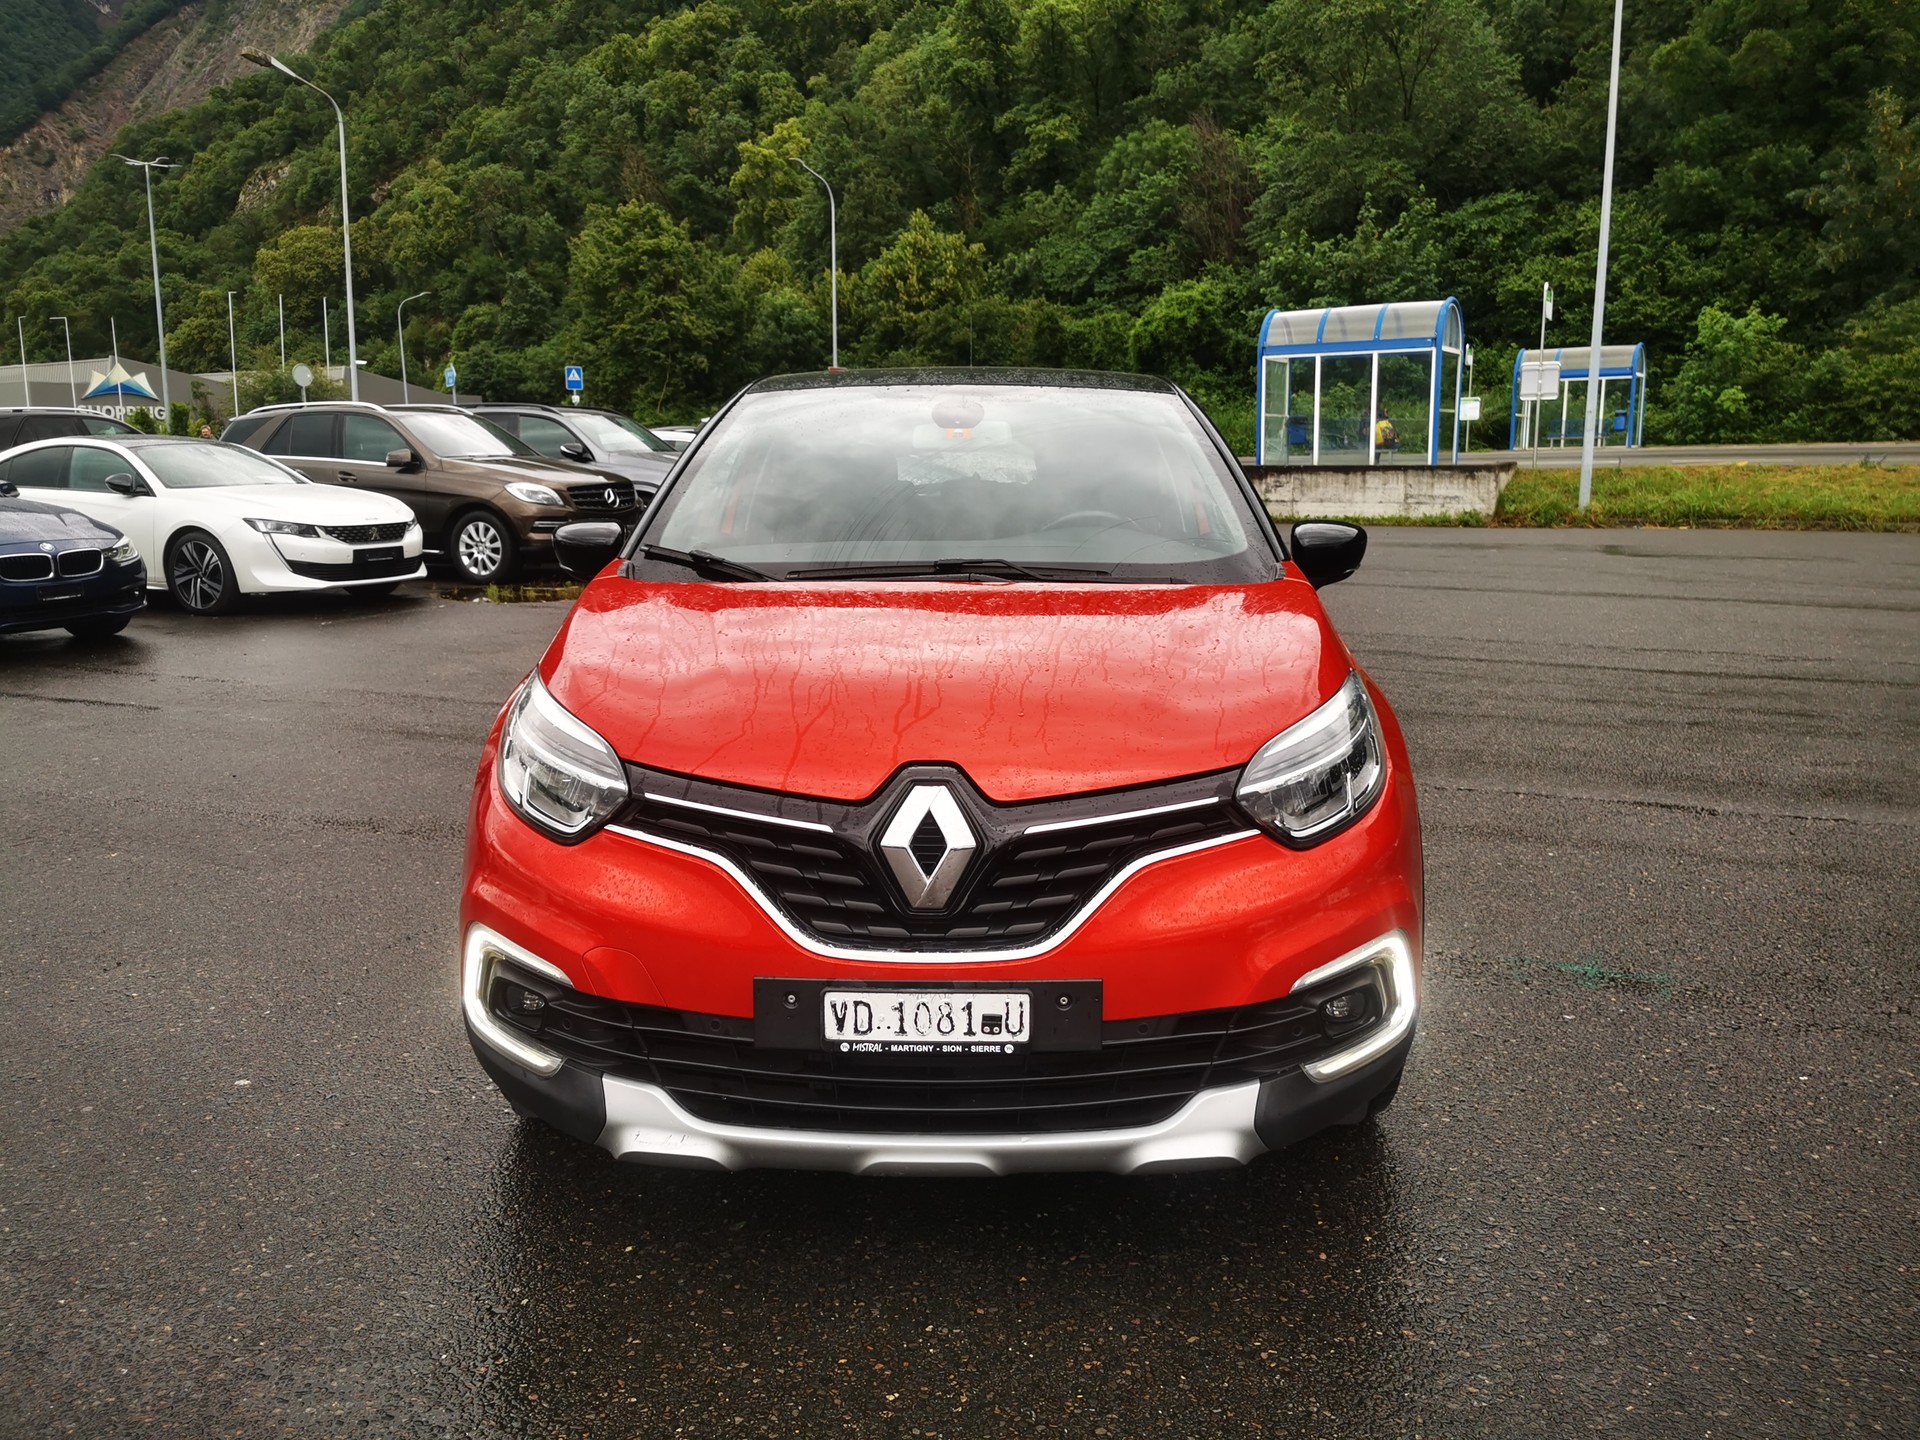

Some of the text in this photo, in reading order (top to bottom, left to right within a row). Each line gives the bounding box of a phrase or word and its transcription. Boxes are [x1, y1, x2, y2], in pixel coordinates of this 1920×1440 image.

[77, 405, 166, 420] SHOPPG
[830, 1000, 1025, 1036] VD 1081 U
[852, 1043, 883, 1053] MISTRAL
[891, 1044, 934, 1053] MARTIGNY
[942, 1045, 963, 1053] SION
[970, 1045, 1001, 1053] SIERRE
